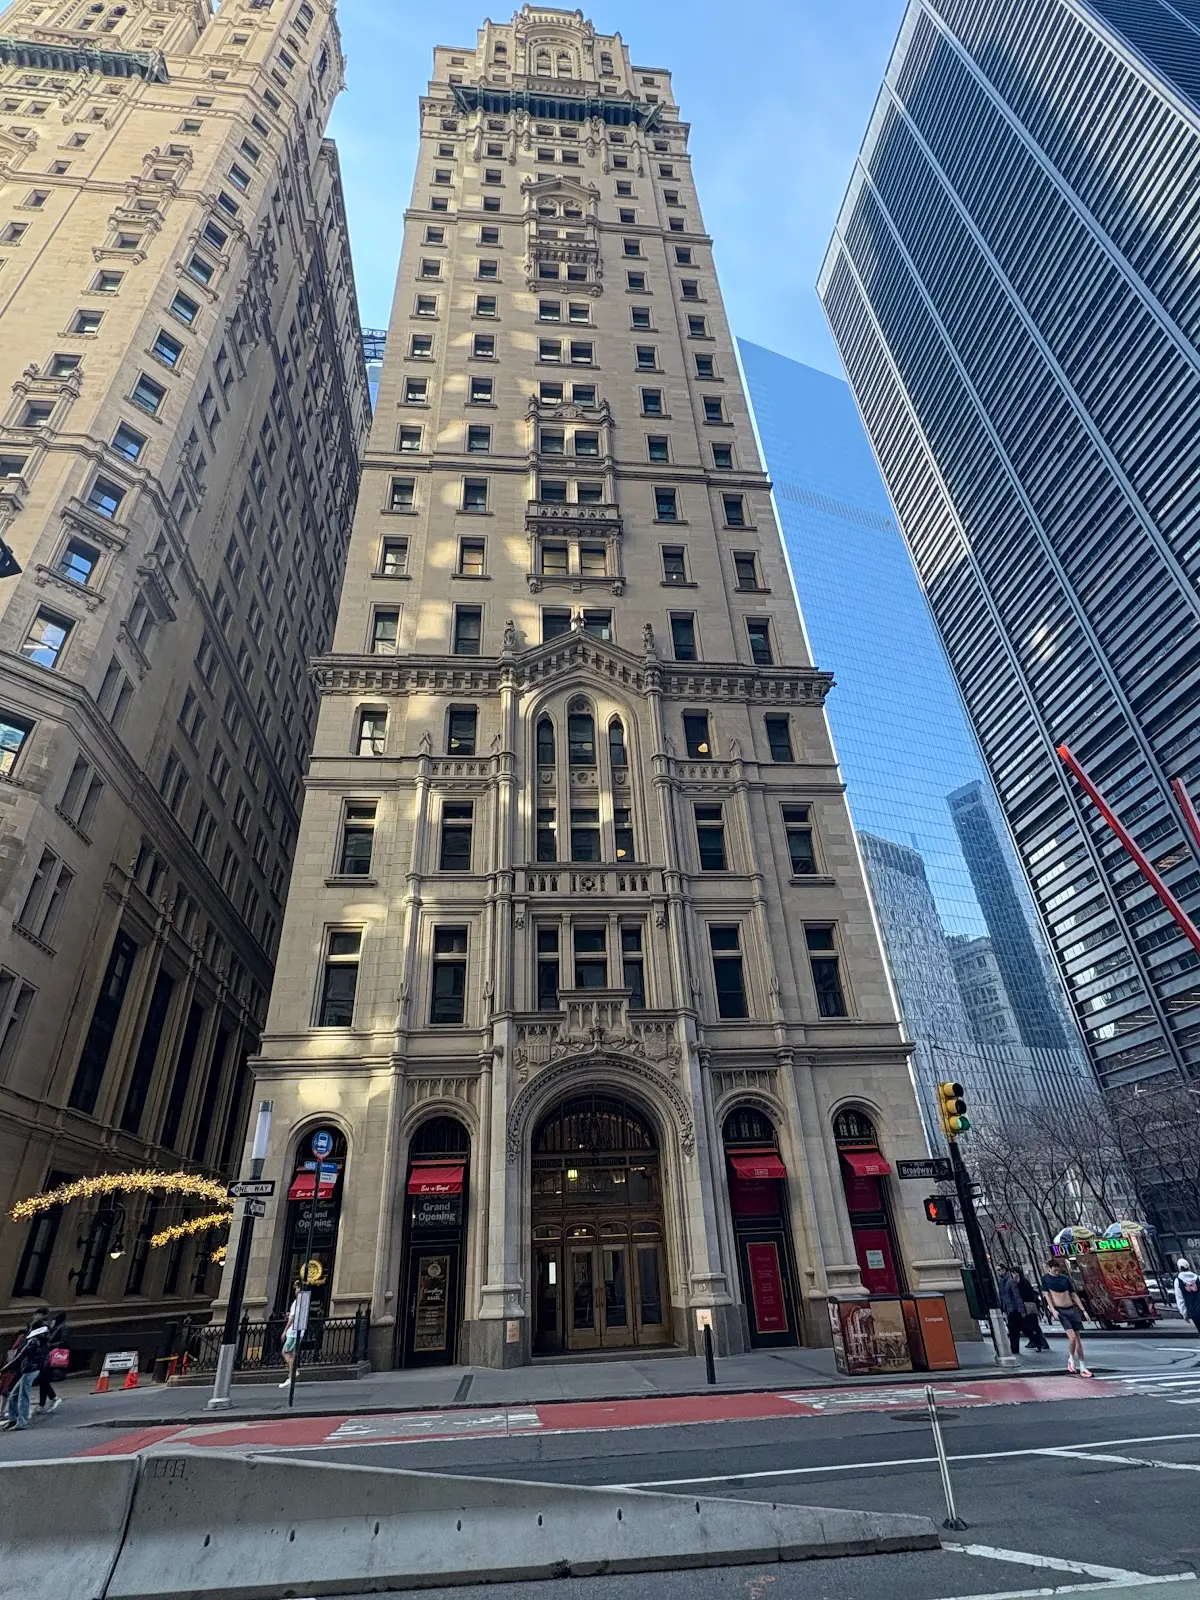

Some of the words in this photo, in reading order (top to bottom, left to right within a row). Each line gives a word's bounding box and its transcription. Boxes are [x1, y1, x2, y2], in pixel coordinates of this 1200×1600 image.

[902, 1166, 933, 1175] Broadway
[423, 1202, 450, 1211] Grand
[418, 1211, 456, 1222] Opening
[298, 1219, 332, 1229] Opning
[1052, 1244, 1070, 1257] HOT
[1070, 1242, 1090, 1255] DOG
